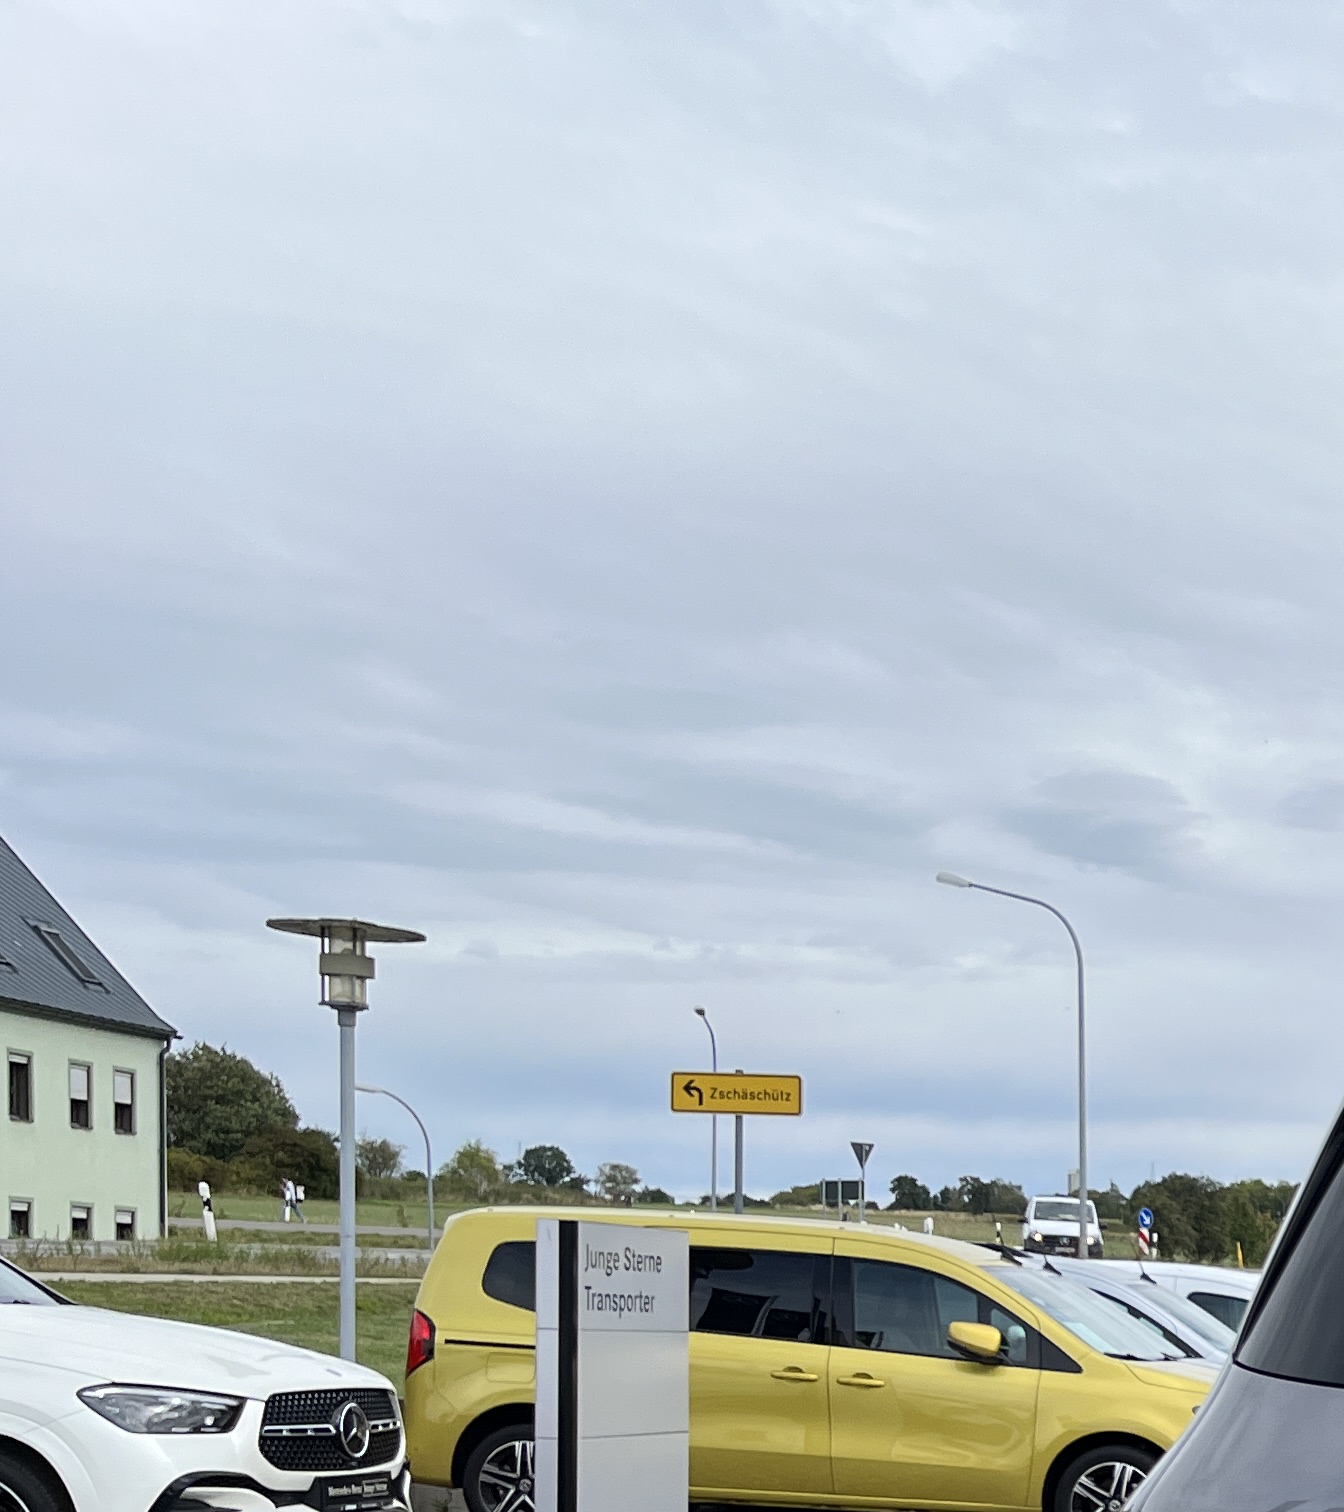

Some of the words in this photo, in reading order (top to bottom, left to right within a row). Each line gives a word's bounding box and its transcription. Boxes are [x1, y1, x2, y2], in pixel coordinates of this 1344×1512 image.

[585, 1243, 620, 1277] Junge
[624, 1246, 662, 1273] Sterne
[584, 1286, 655, 1319] Transporter
